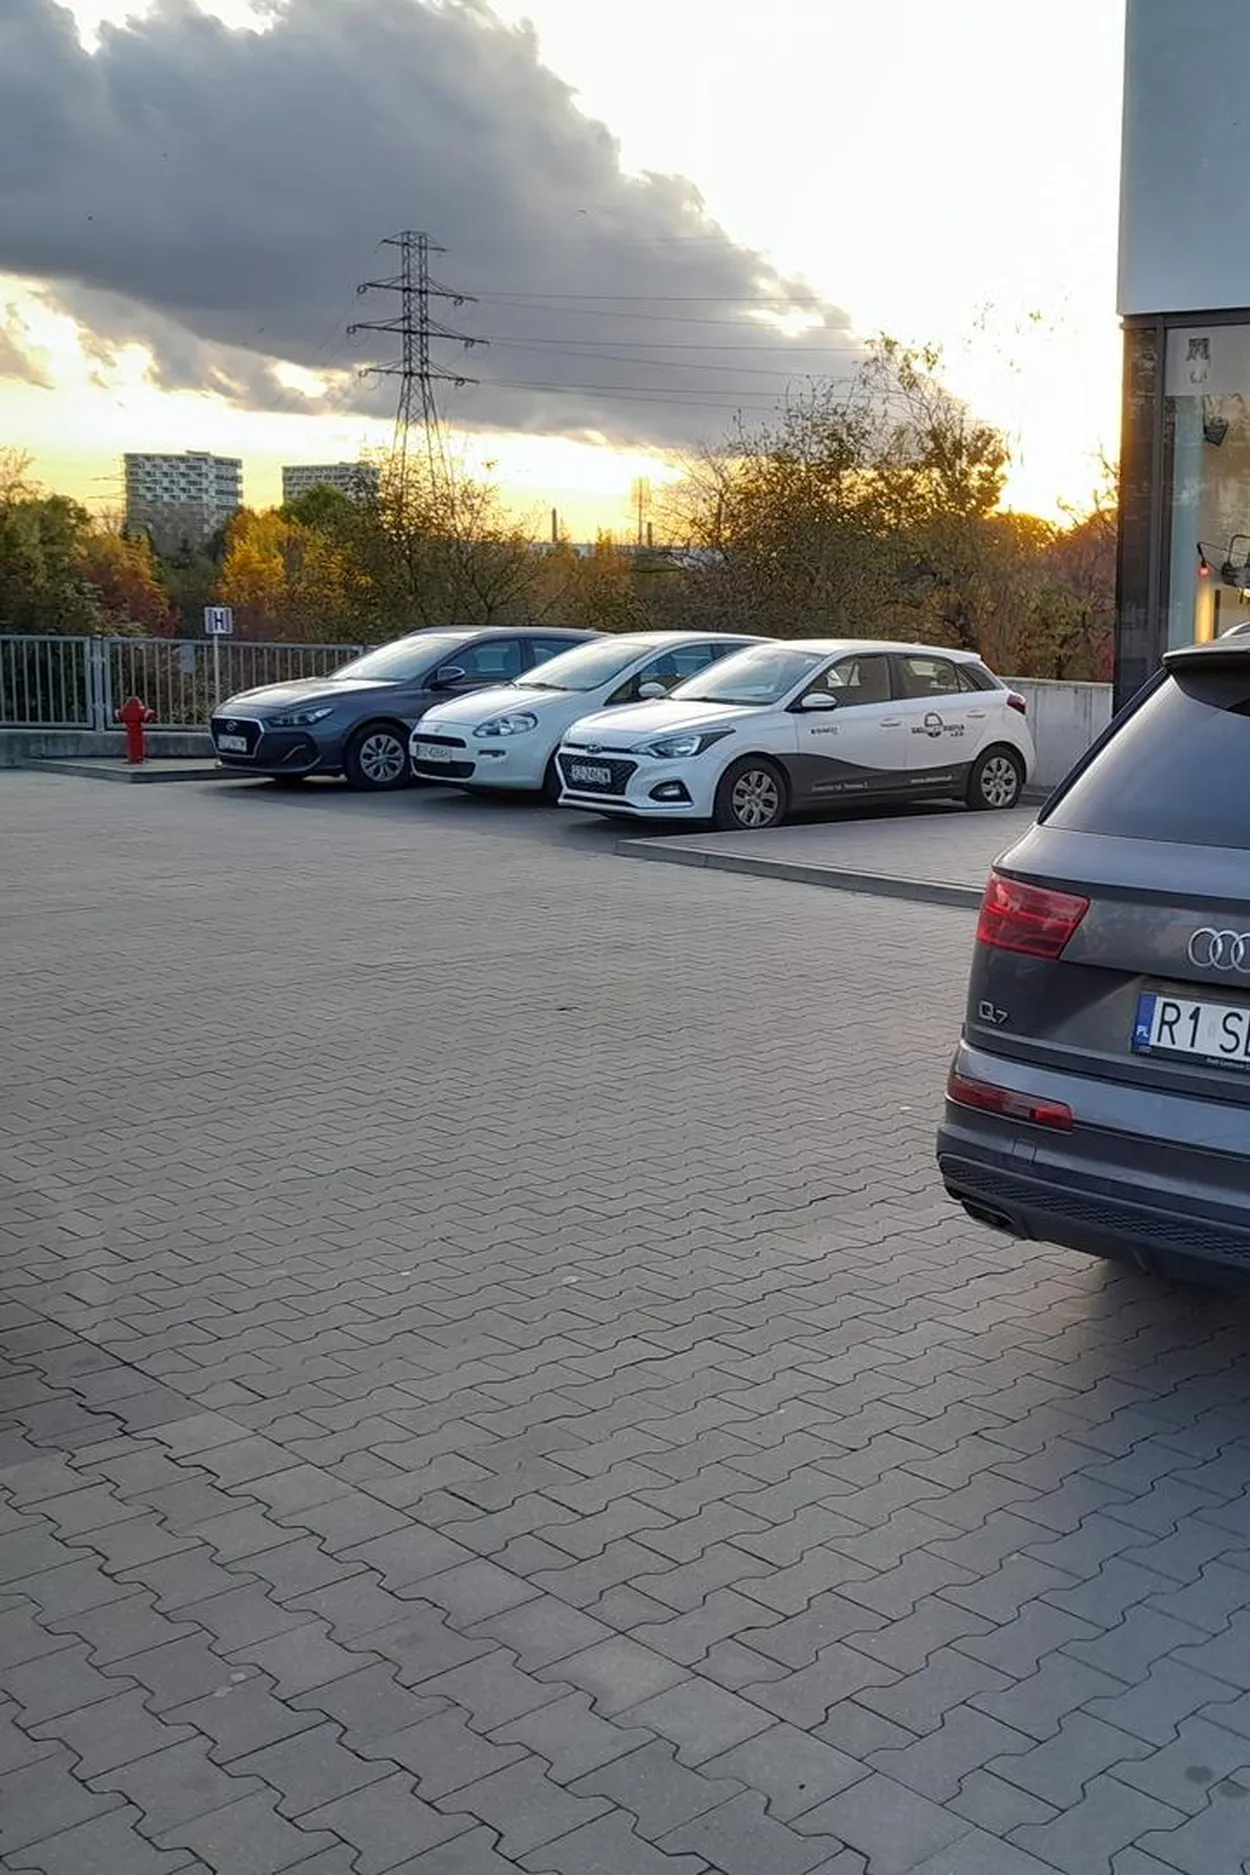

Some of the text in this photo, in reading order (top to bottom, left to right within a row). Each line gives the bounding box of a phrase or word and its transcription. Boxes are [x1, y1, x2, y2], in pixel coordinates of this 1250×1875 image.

[214, 611, 224, 630] H
[979, 1000, 1008, 1024] Q7
[1137, 1025, 1149, 1037] PL
[1157, 1001, 1201, 1048] R1
